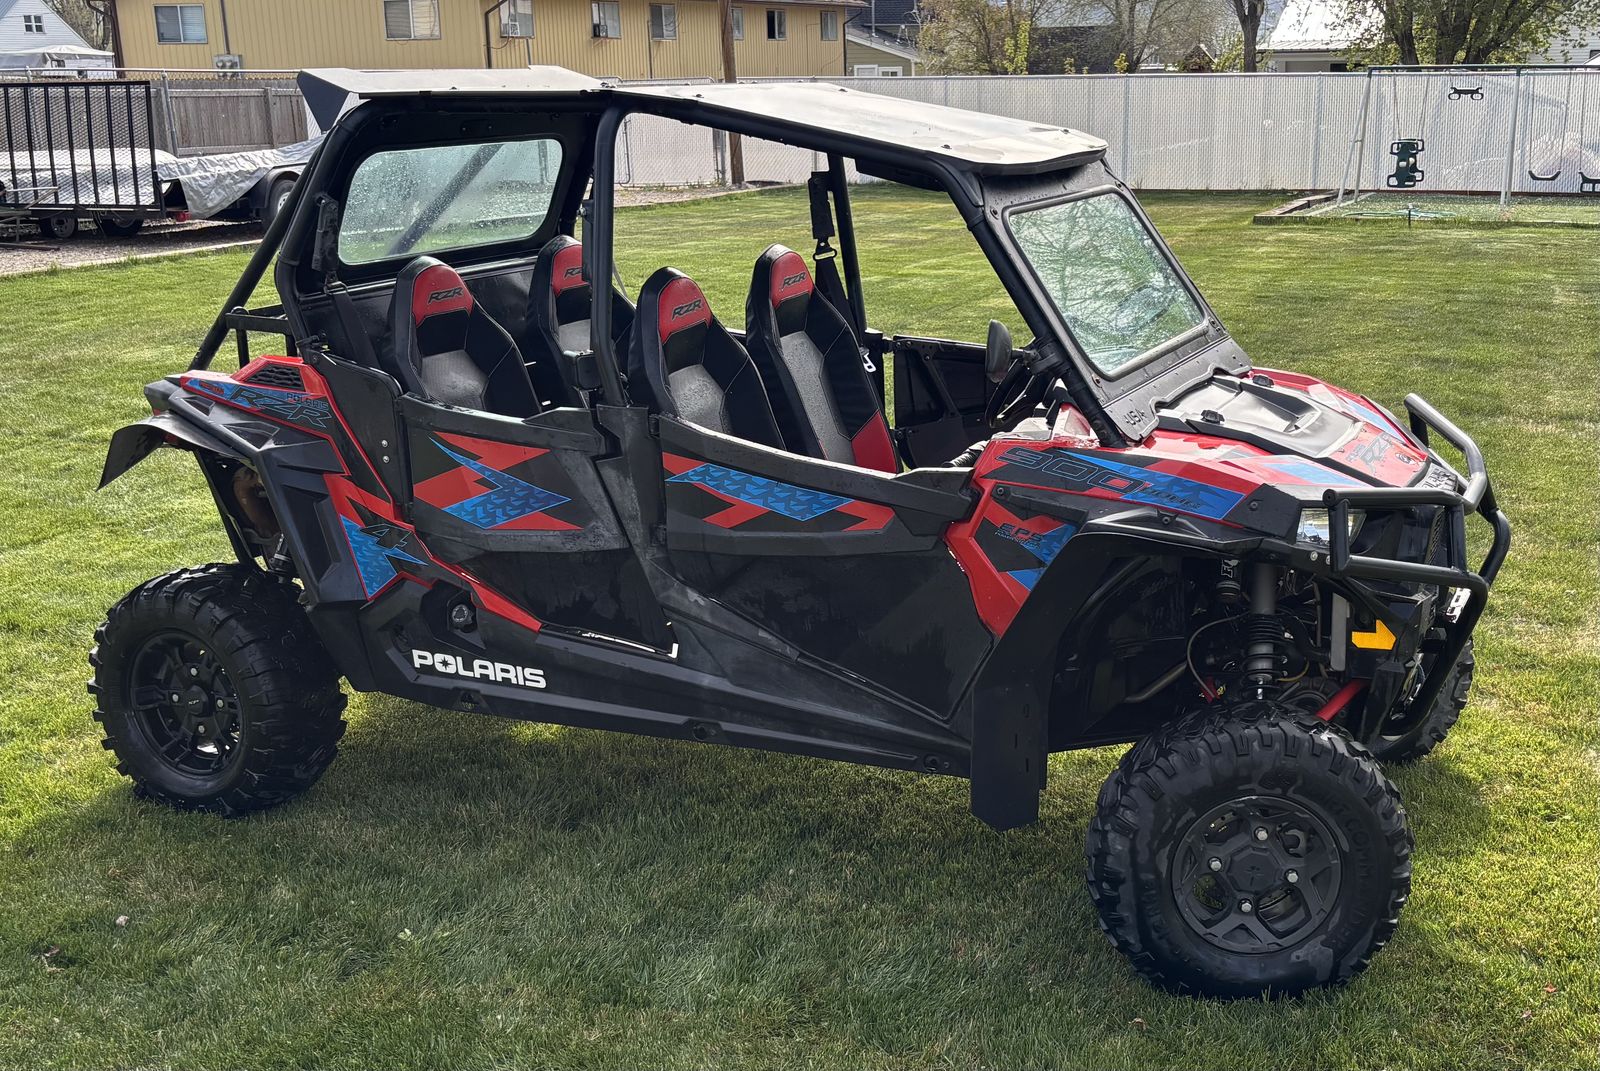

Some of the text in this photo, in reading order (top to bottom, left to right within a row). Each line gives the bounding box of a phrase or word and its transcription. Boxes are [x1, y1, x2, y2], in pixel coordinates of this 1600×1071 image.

[563, 266, 582, 281] RZ
[781, 271, 806, 291] RZR
[427, 286, 464, 305] RZR
[671, 298, 703, 321] RZR
[229, 384, 333, 429] RZR
[995, 446, 1147, 495] 900
[1000, 522, 1045, 543] EPS
[411, 649, 547, 689] POLARIS
